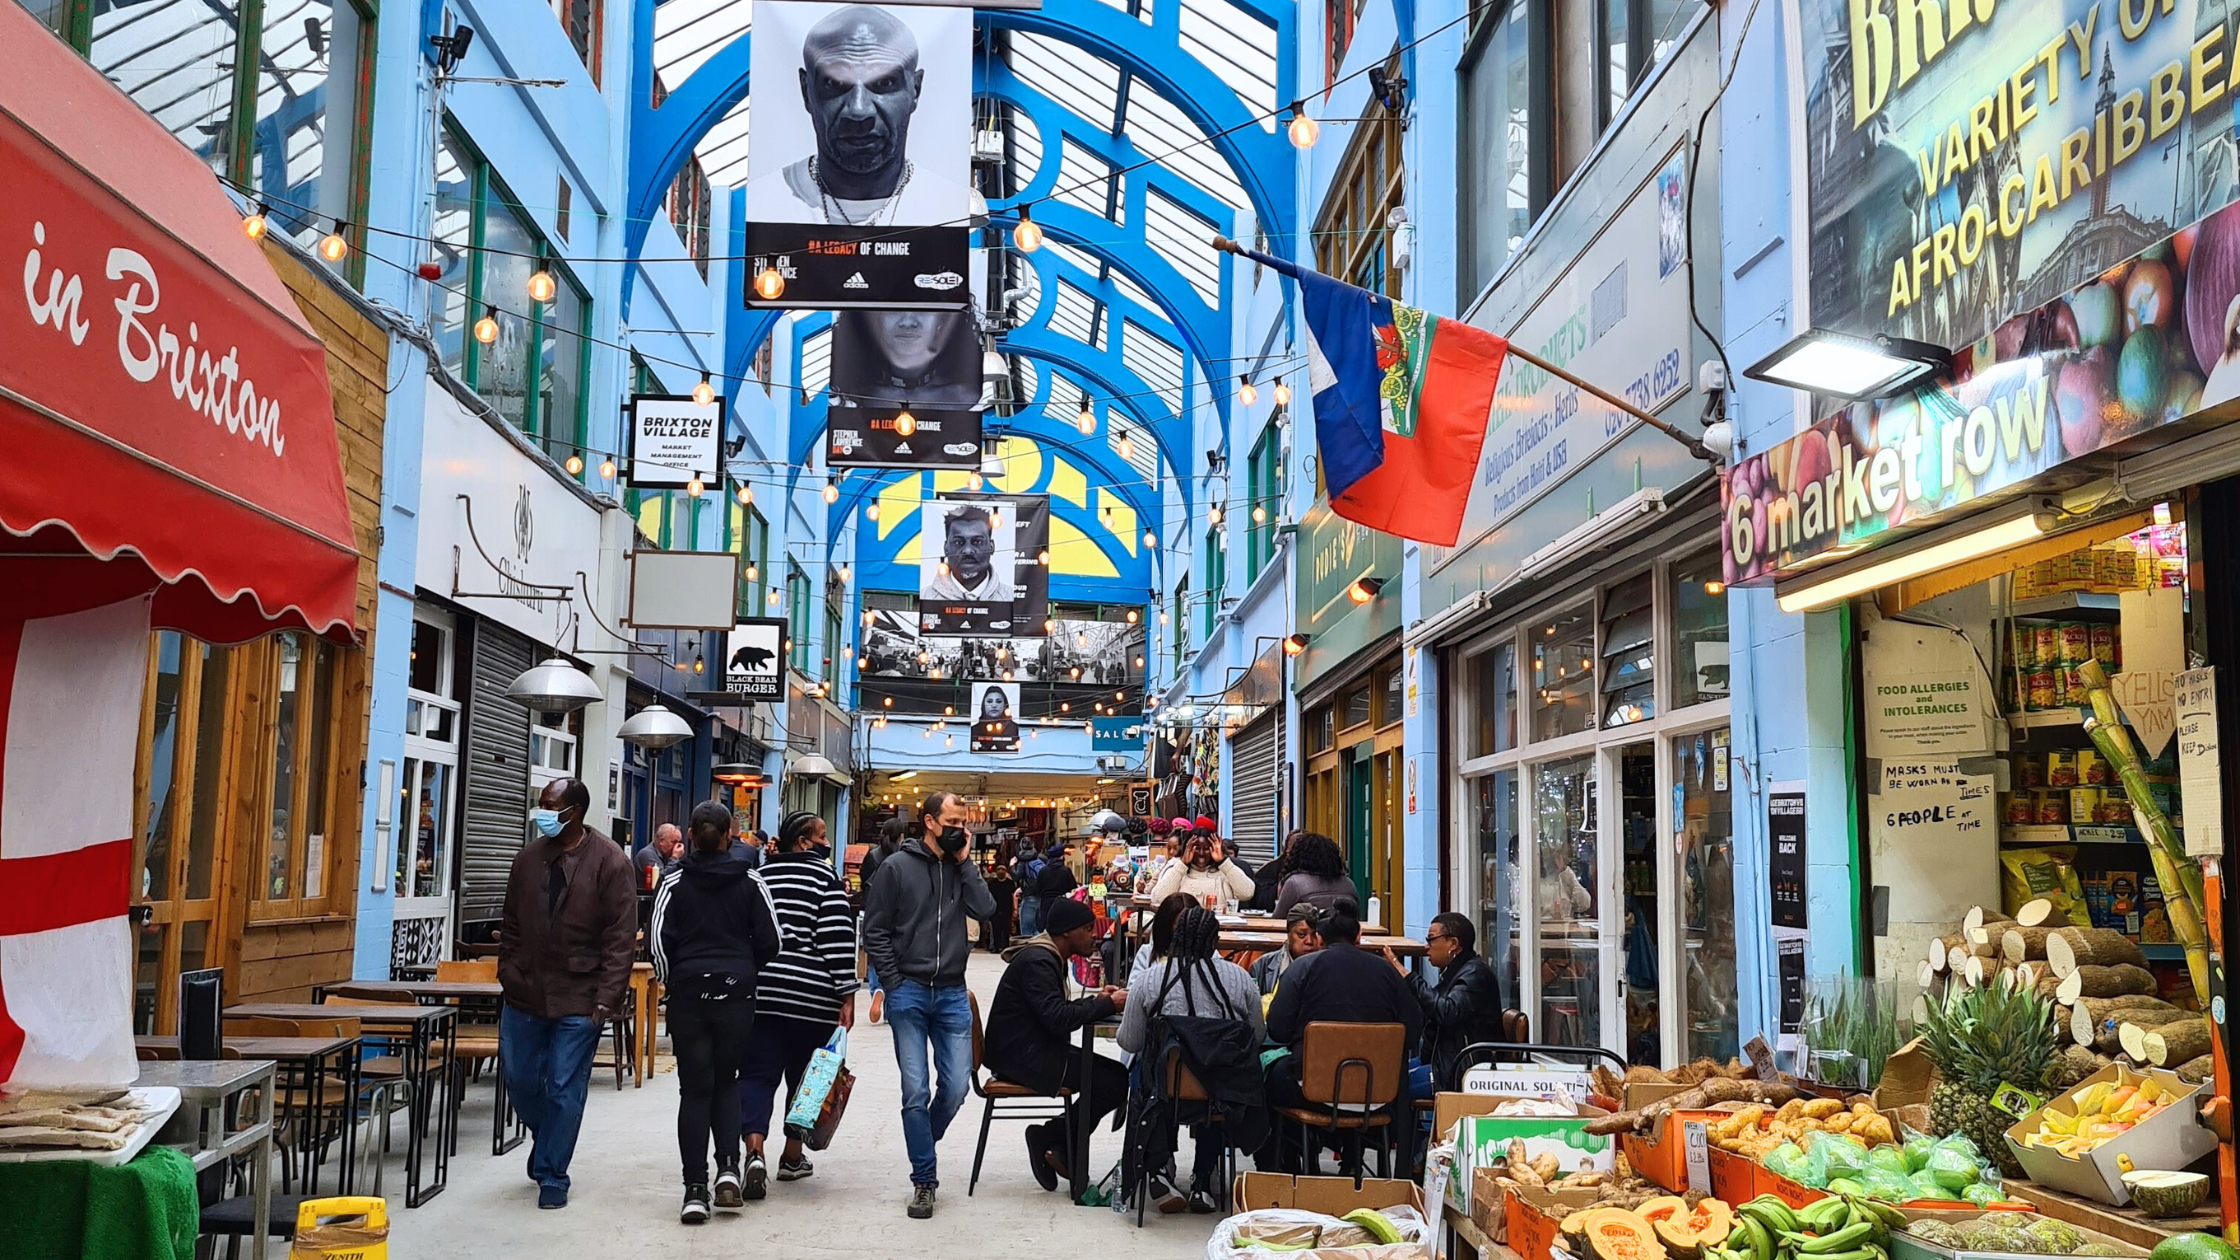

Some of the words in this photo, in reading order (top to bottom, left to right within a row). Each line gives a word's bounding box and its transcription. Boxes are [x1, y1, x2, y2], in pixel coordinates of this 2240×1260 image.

[1917, 3, 2101, 199] VARIETY
[2117, 0, 2176, 42] O
[824, 241, 858, 256] LEGACY
[860, 241, 872, 256] OF
[874, 241, 910, 257] CHANGE
[843, 281, 870, 289] adidas
[23, 220, 90, 346] in
[105, 247, 285, 458] Brixton
[1653, 348, 1680, 401] 6252
[643, 416, 713, 428] BRIXTON
[916, 421, 942, 431] CHANGE
[643, 427, 711, 438] VILLAGE
[1485, 443, 1515, 488] Religious
[1546, 451, 1552, 475] &
[1730, 494, 1755, 566] 6
[1767, 428, 1923, 554] market
[726, 683, 778, 694] BURGER
[1877, 685, 1908, 696] FOOD
[1910, 681, 1970, 694] ALLERGIES
[1915, 694, 1933, 703] and
[1884, 703, 1968, 717] INTOLERANCES
[2134, 706, 2175, 736] YAM
[1886, 764, 1927, 778] MASKS
[1933, 764, 1960, 774] MUST
[1889, 780, 1902, 789] BE
[1907, 778, 1938, 788] WORN
[1960, 785, 1991, 797] TIMES
[1886, 813, 1896, 827] 6
[1898, 805, 1956, 827] PEOPLE
[1961, 810, 1972, 818] AT
[1956, 819, 1981, 832] TIME
[1778, 842, 1797, 854] BACK
[1470, 1080, 1528, 1092] ORIGINAL
